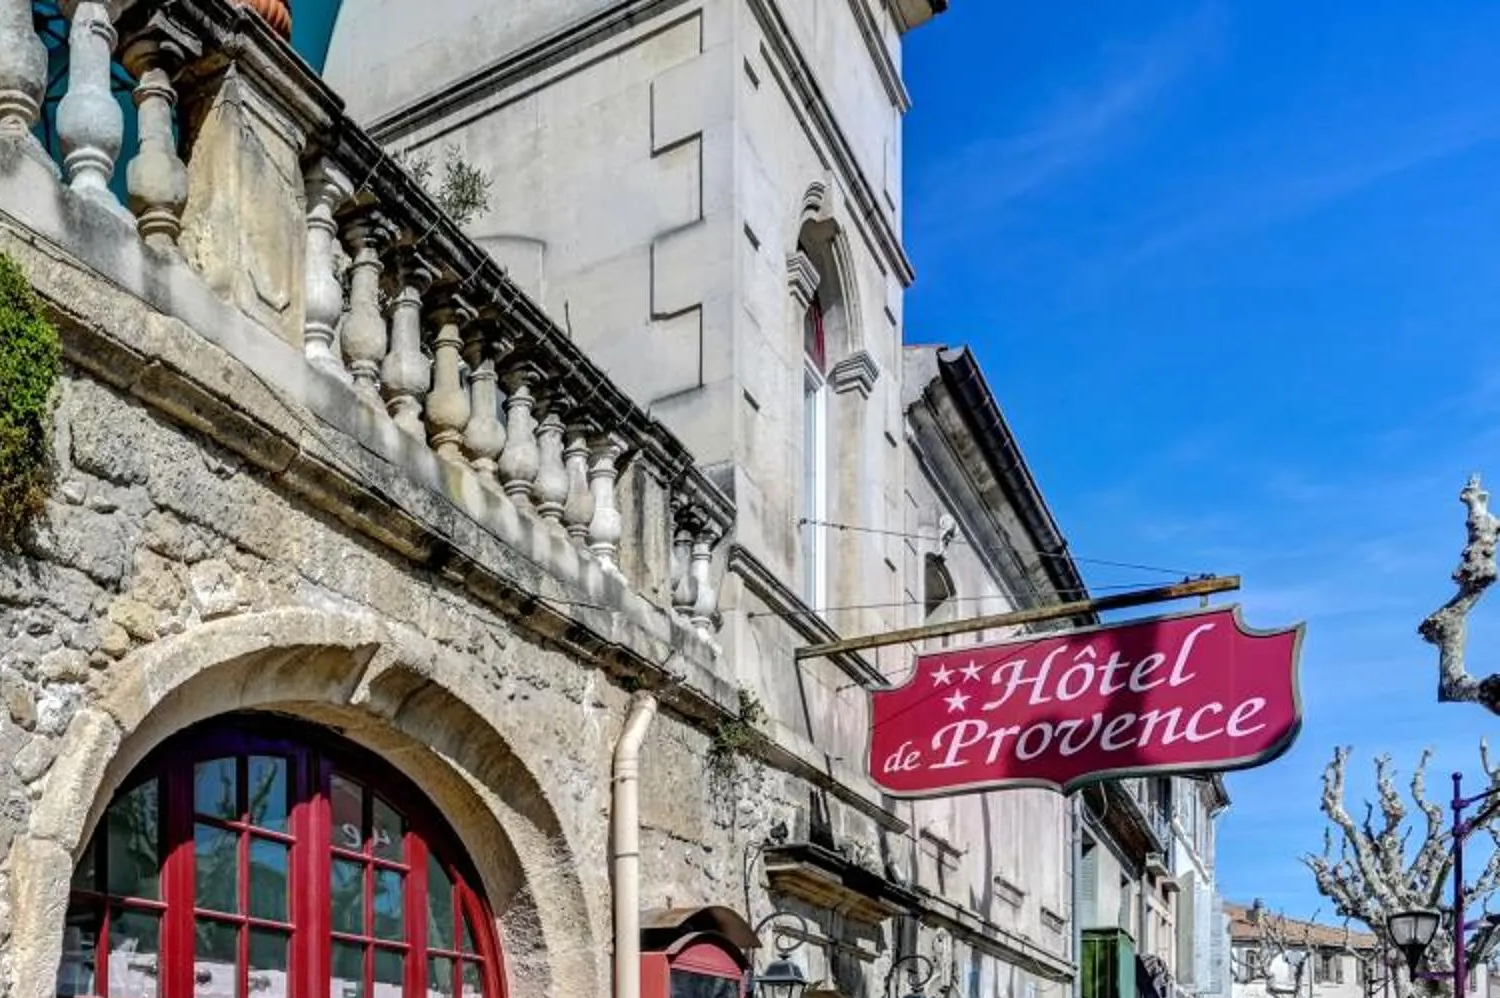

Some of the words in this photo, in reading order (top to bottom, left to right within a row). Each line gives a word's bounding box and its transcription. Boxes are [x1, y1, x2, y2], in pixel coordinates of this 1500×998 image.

[982, 623, 1216, 711] Hôtel
[883, 741, 921, 774] de
[929, 695, 1267, 769] Provence
